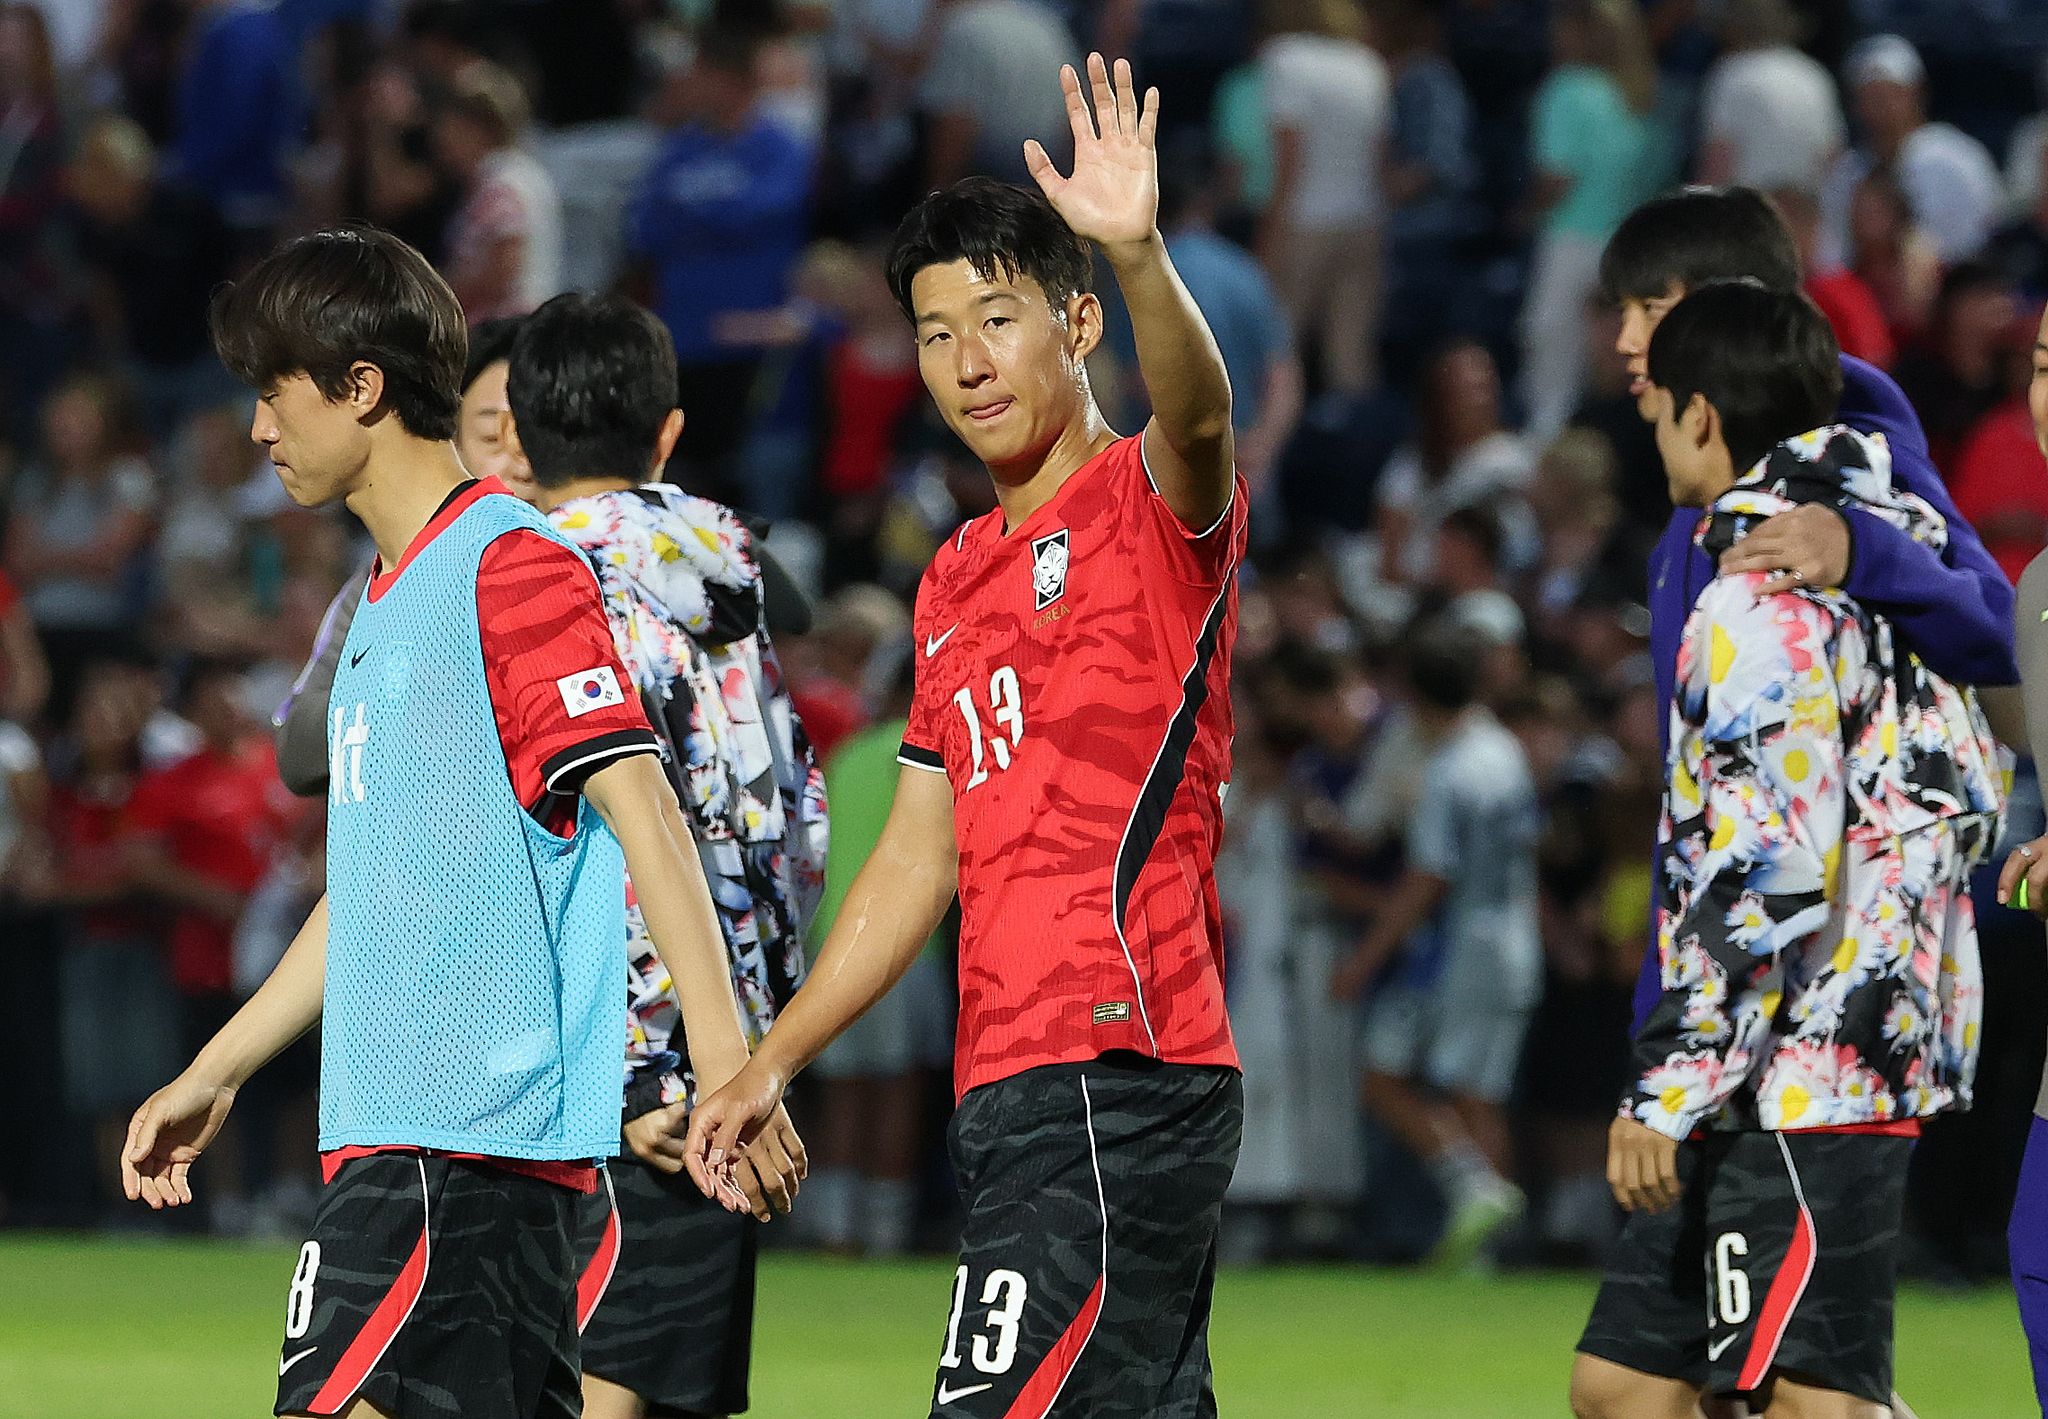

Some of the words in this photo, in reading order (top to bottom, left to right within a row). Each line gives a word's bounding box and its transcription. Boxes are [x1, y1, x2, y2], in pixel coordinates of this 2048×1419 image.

[1033, 603, 1071, 631] KOREA
[953, 665, 1024, 793] 13
[286, 1240, 321, 1339] 8
[940, 1264, 1028, 1374] 13
